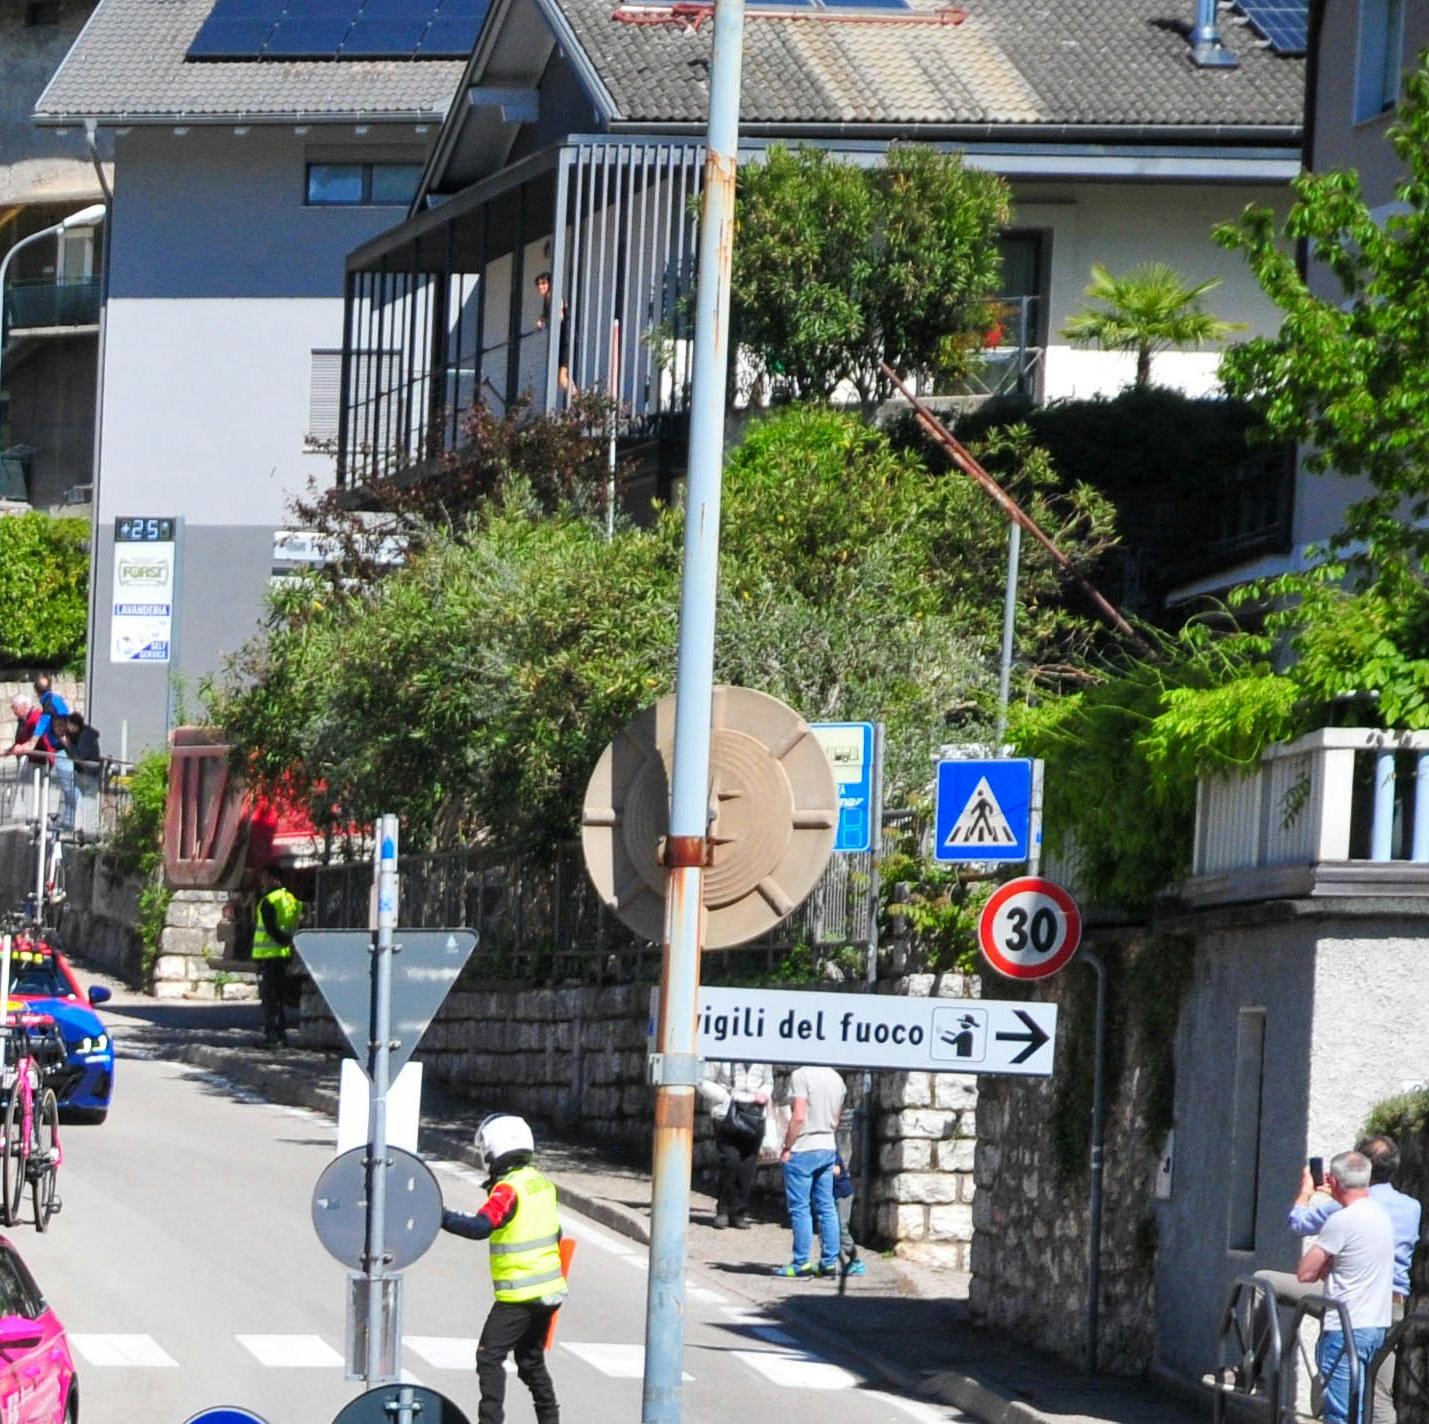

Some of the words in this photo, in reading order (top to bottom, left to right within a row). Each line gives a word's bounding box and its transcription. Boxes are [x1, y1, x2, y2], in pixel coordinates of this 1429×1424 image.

[116, 605, 168, 615] LAVANDERIA
[1005, 906, 1058, 953] 30
[779, 1009, 826, 1041] del
[841, 1012, 924, 1046] fuoco
